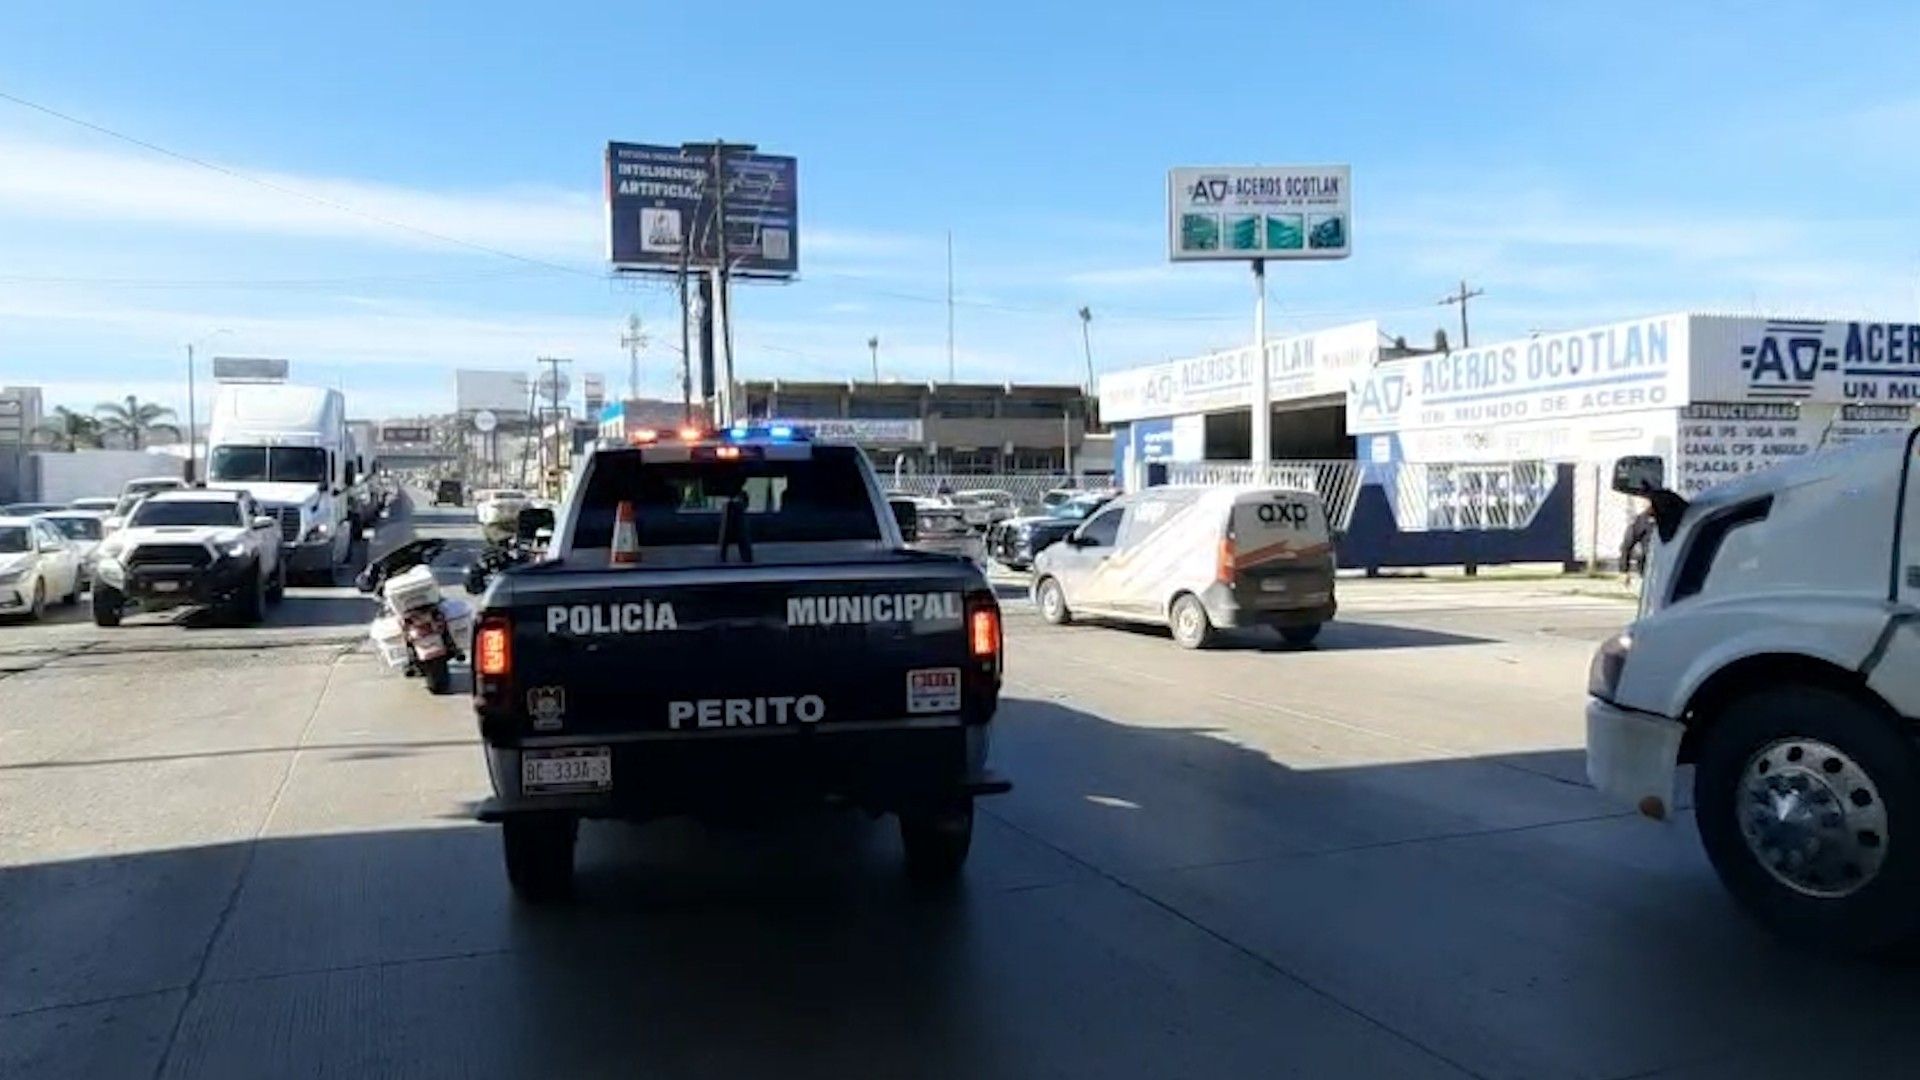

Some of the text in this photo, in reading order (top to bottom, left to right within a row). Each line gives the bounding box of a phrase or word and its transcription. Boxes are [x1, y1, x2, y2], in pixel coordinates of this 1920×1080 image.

[1237, 176, 1339, 196] ACEROS OCOTLAN
[1182, 353, 1235, 387] ACEROS
[1421, 322, 1668, 395] ACEROS OCOTLAN
[1456, 401, 1528, 421] MUNDO
[1541, 395, 1569, 411] DE
[1581, 385, 1667, 408] ACERO
[1844, 382, 1877, 398] UN
[1684, 443, 1727, 455] CANAL
[1731, 443, 1755, 455] CPS
[1685, 461, 1739, 473] PLACAS
[1259, 504, 1307, 531] axp
[787, 591, 960, 626] MUNICIPAL
[668, 694, 826, 729] PERITO
